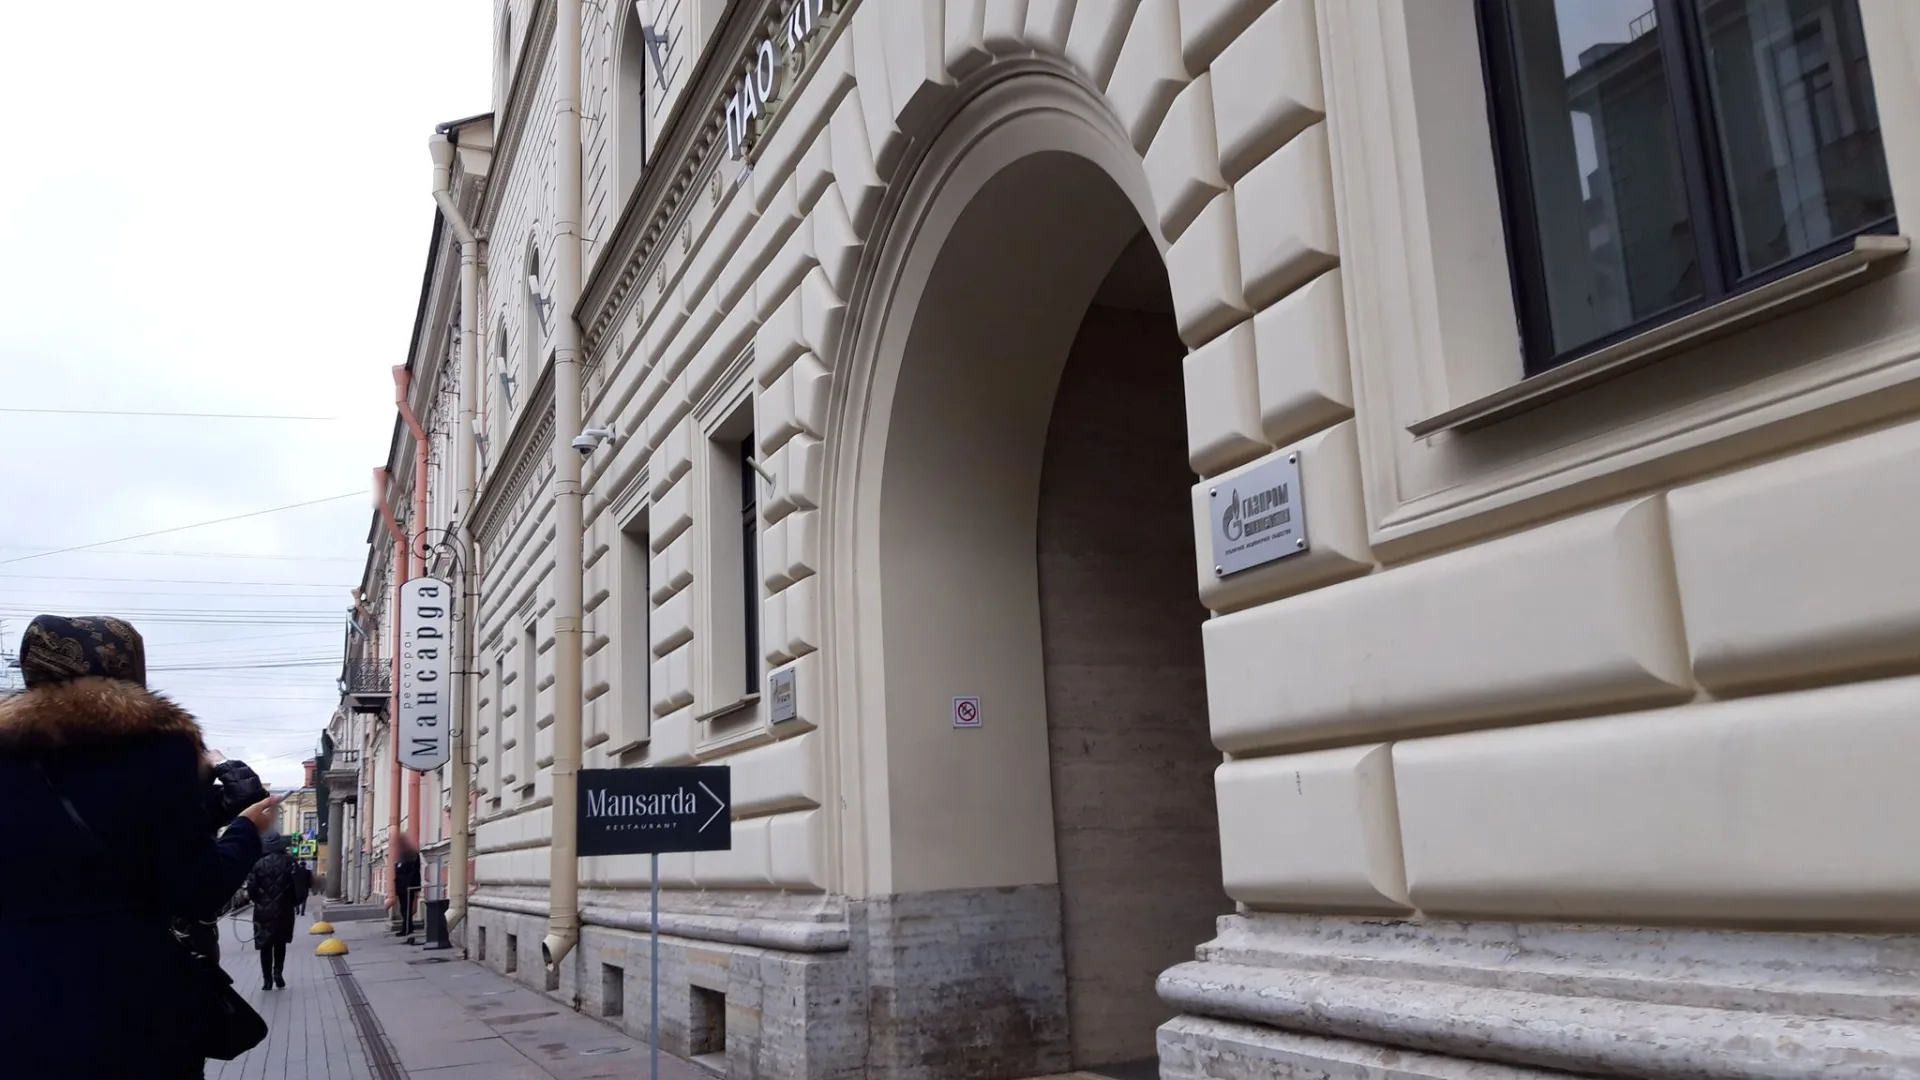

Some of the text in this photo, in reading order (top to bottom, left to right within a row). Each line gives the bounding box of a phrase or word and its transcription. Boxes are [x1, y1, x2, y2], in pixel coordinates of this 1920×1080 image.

[726, 39, 774, 160] ПАО
[1242, 482, 1289, 519] ГАЗПРОМ
[404, 631, 413, 709] ресторан
[411, 585, 443, 756] Мансарда
[586, 787, 698, 817] Mansarda
[606, 822, 677, 831] RESTAURANT
